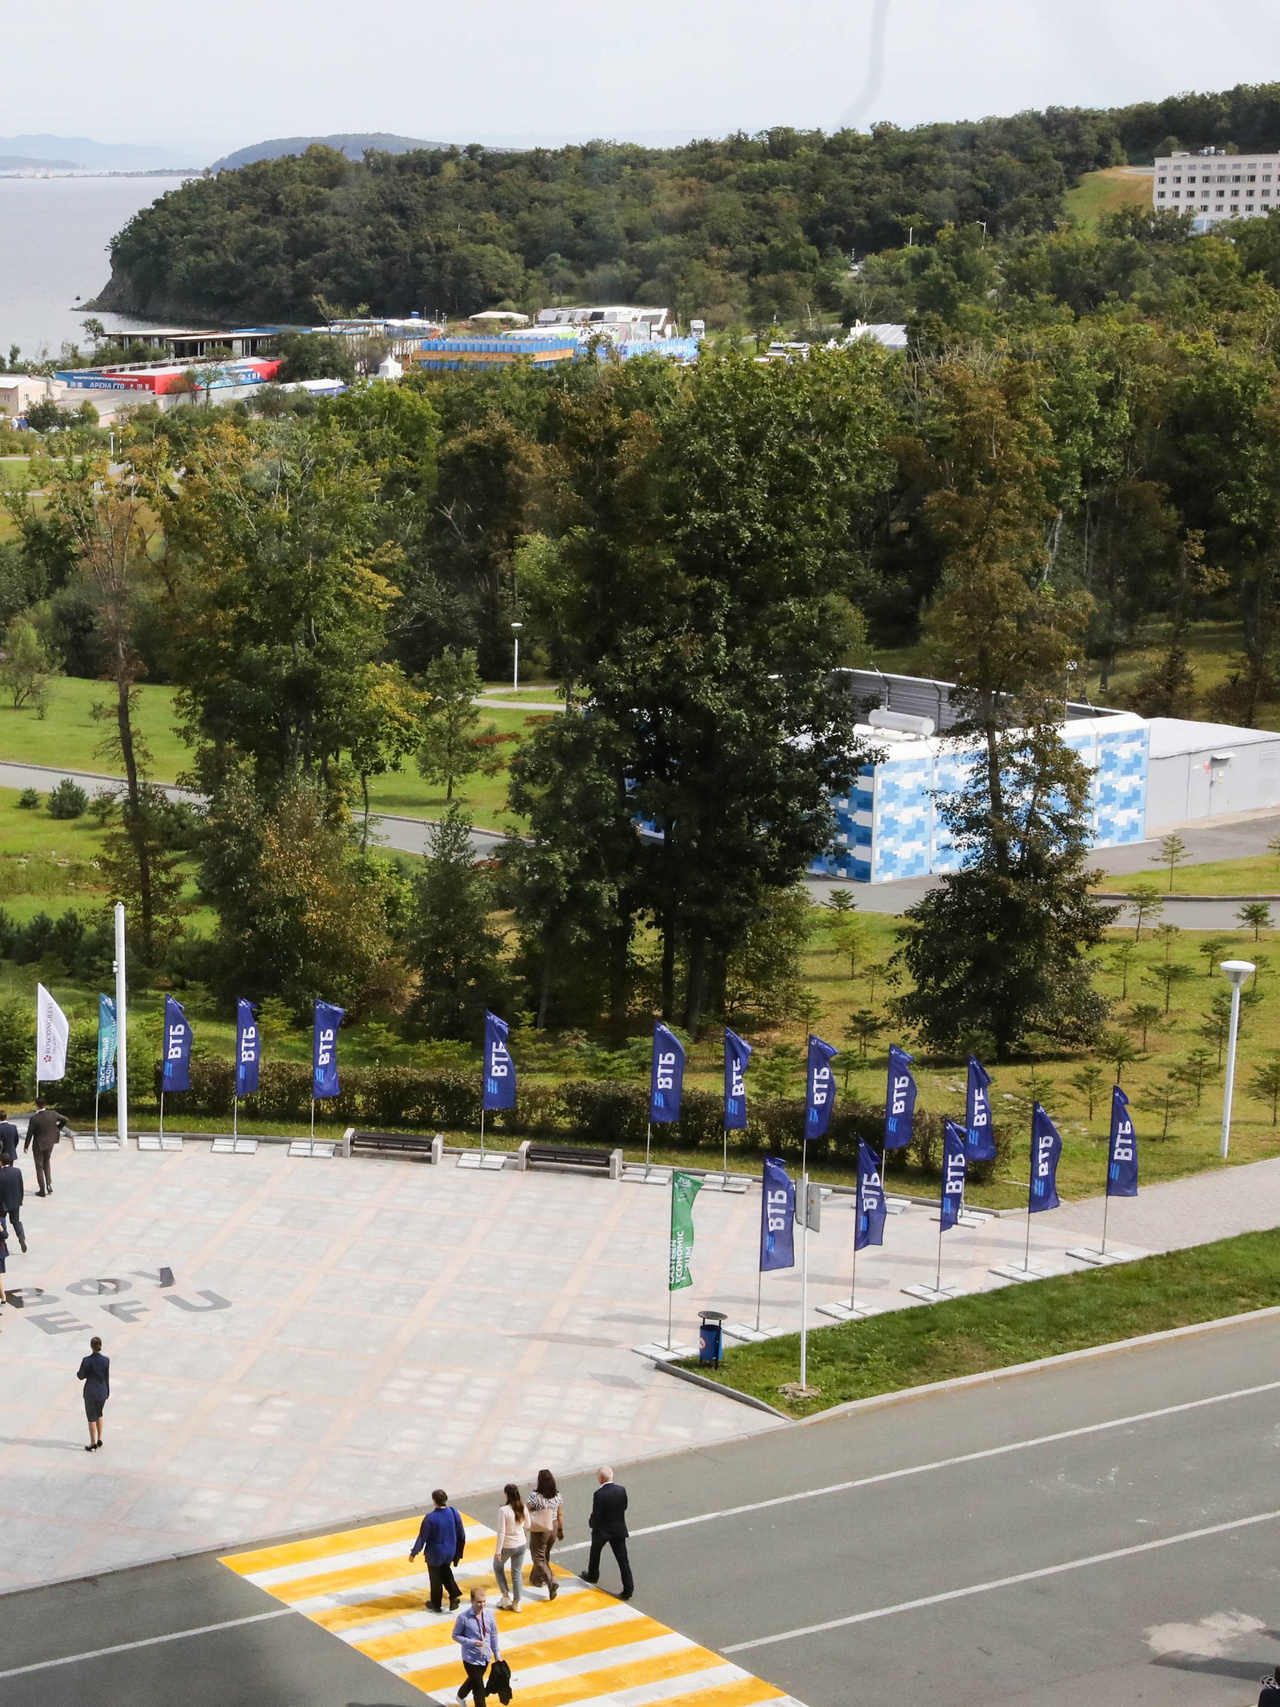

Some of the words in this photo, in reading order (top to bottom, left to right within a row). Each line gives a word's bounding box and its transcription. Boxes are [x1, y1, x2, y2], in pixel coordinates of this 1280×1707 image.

[168, 1024, 184, 1059] ВТБ
[241, 1026, 255, 1061] ВТБ
[319, 1029, 333, 1065] ВТБ
[491, 1042, 507, 1076] ВТБ
[657, 1053, 675, 1089] ВТБ
[814, 1068, 829, 1105] ВТБ
[893, 1076, 908, 1114] ВТБ
[1039, 1136, 1052, 1176] ВТБ
[1115, 1121, 1131, 1161] ВТБ
[862, 1173, 879, 1211] ВТБ
[946, 1154, 964, 1193] ВТБ
[767, 1190, 786, 1231] ВТБ
[676, 1230, 684, 1283] ECONOMIC
